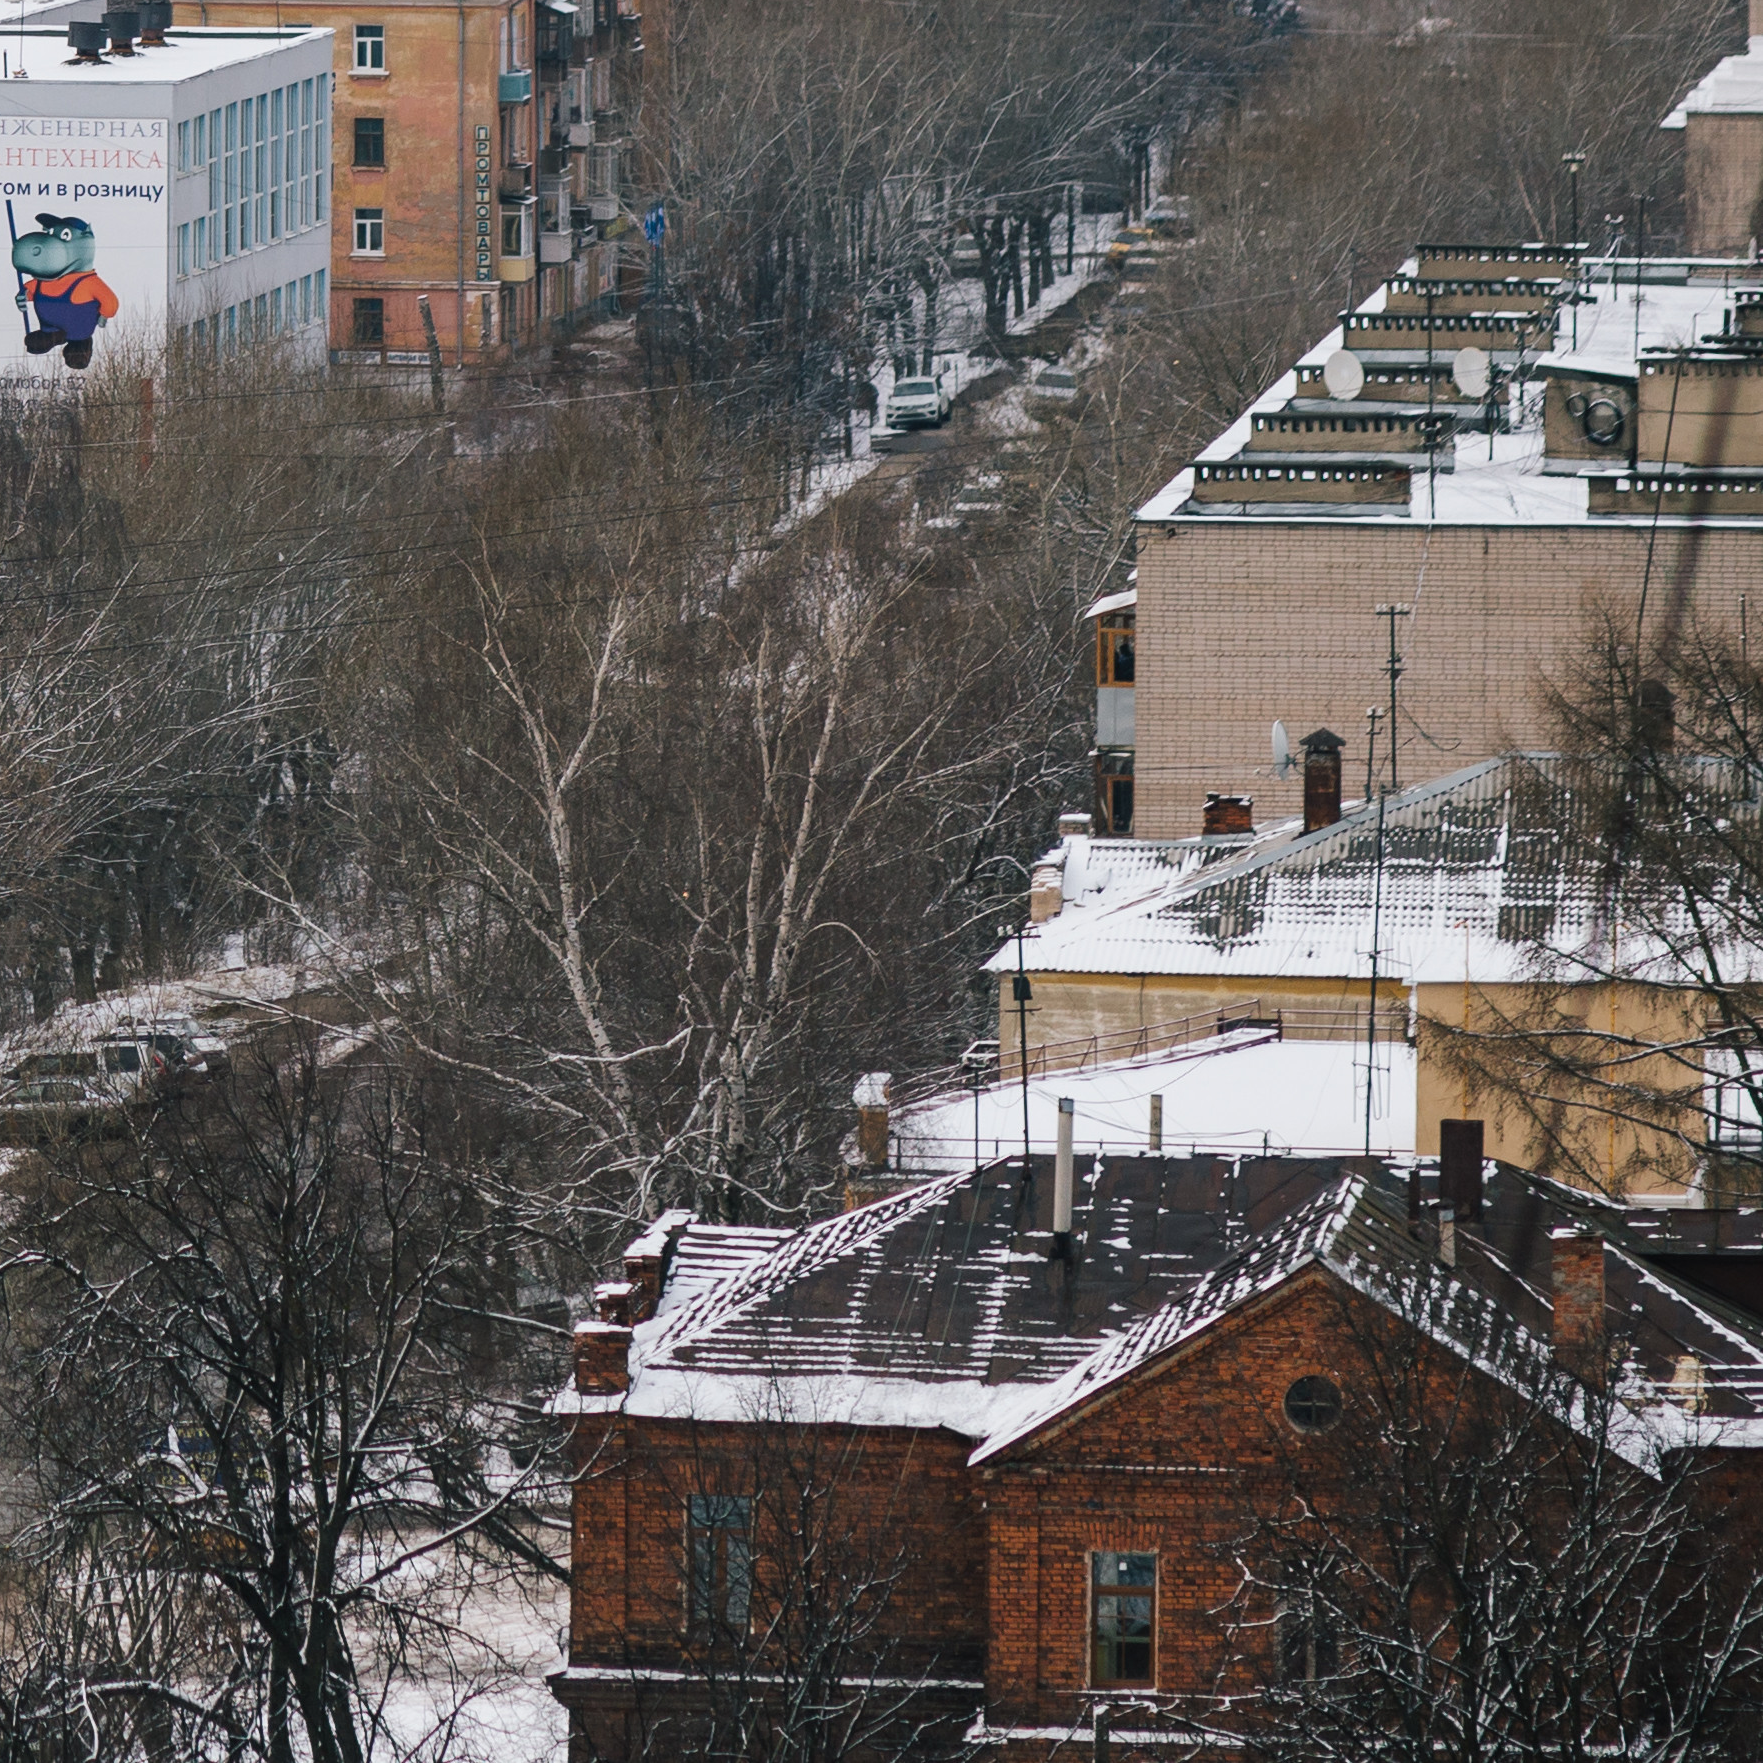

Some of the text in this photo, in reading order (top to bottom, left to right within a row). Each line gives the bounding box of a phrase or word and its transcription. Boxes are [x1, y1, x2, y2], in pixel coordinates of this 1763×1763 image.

[38, 184, 50, 196] и
[57, 184, 68, 197] в
[74, 183, 164, 203] розницу
[476, 126, 491, 281] ПРОМТОВАРЫ
